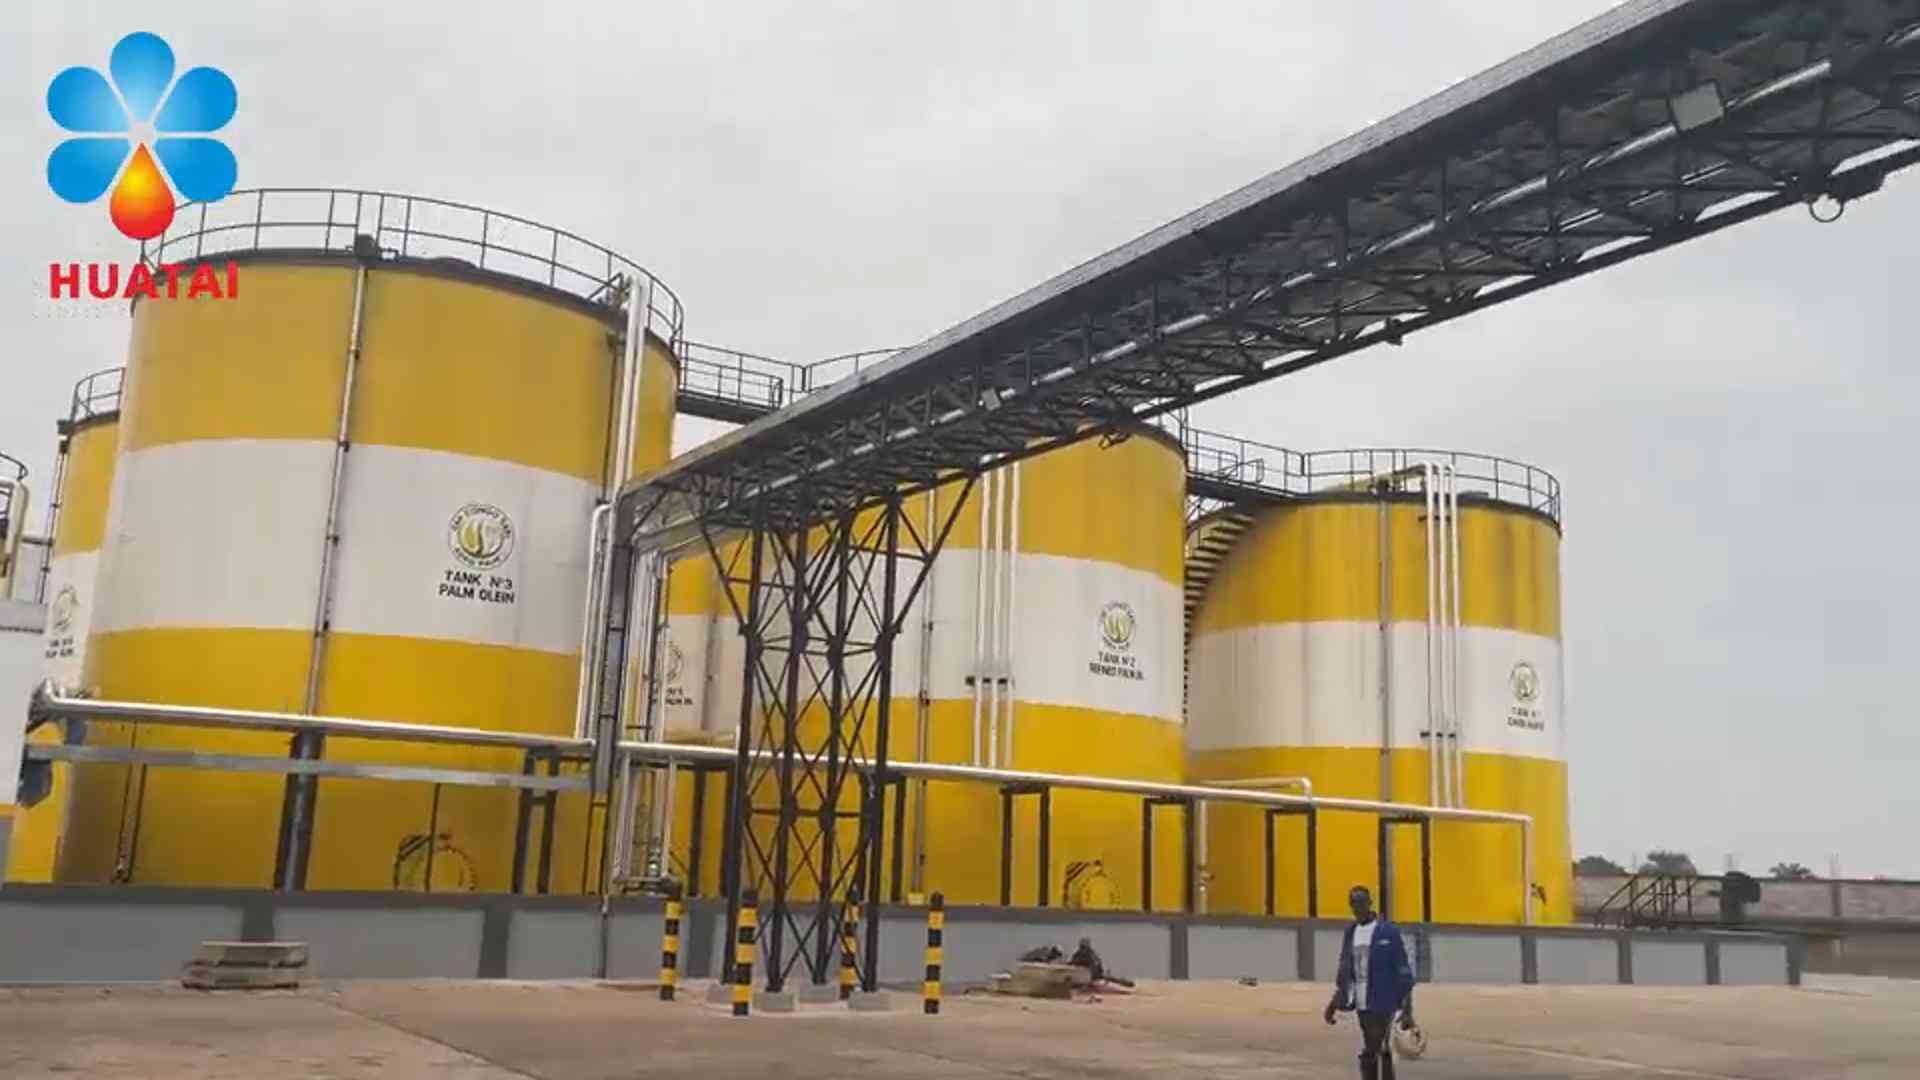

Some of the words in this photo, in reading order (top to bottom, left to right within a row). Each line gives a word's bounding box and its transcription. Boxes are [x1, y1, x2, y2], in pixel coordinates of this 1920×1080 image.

[445, 569, 481, 586] TANK
[438, 582, 475, 600] PALM
[478, 587, 515, 604] OLEIN
[1098, 650, 1120, 665] TANK
